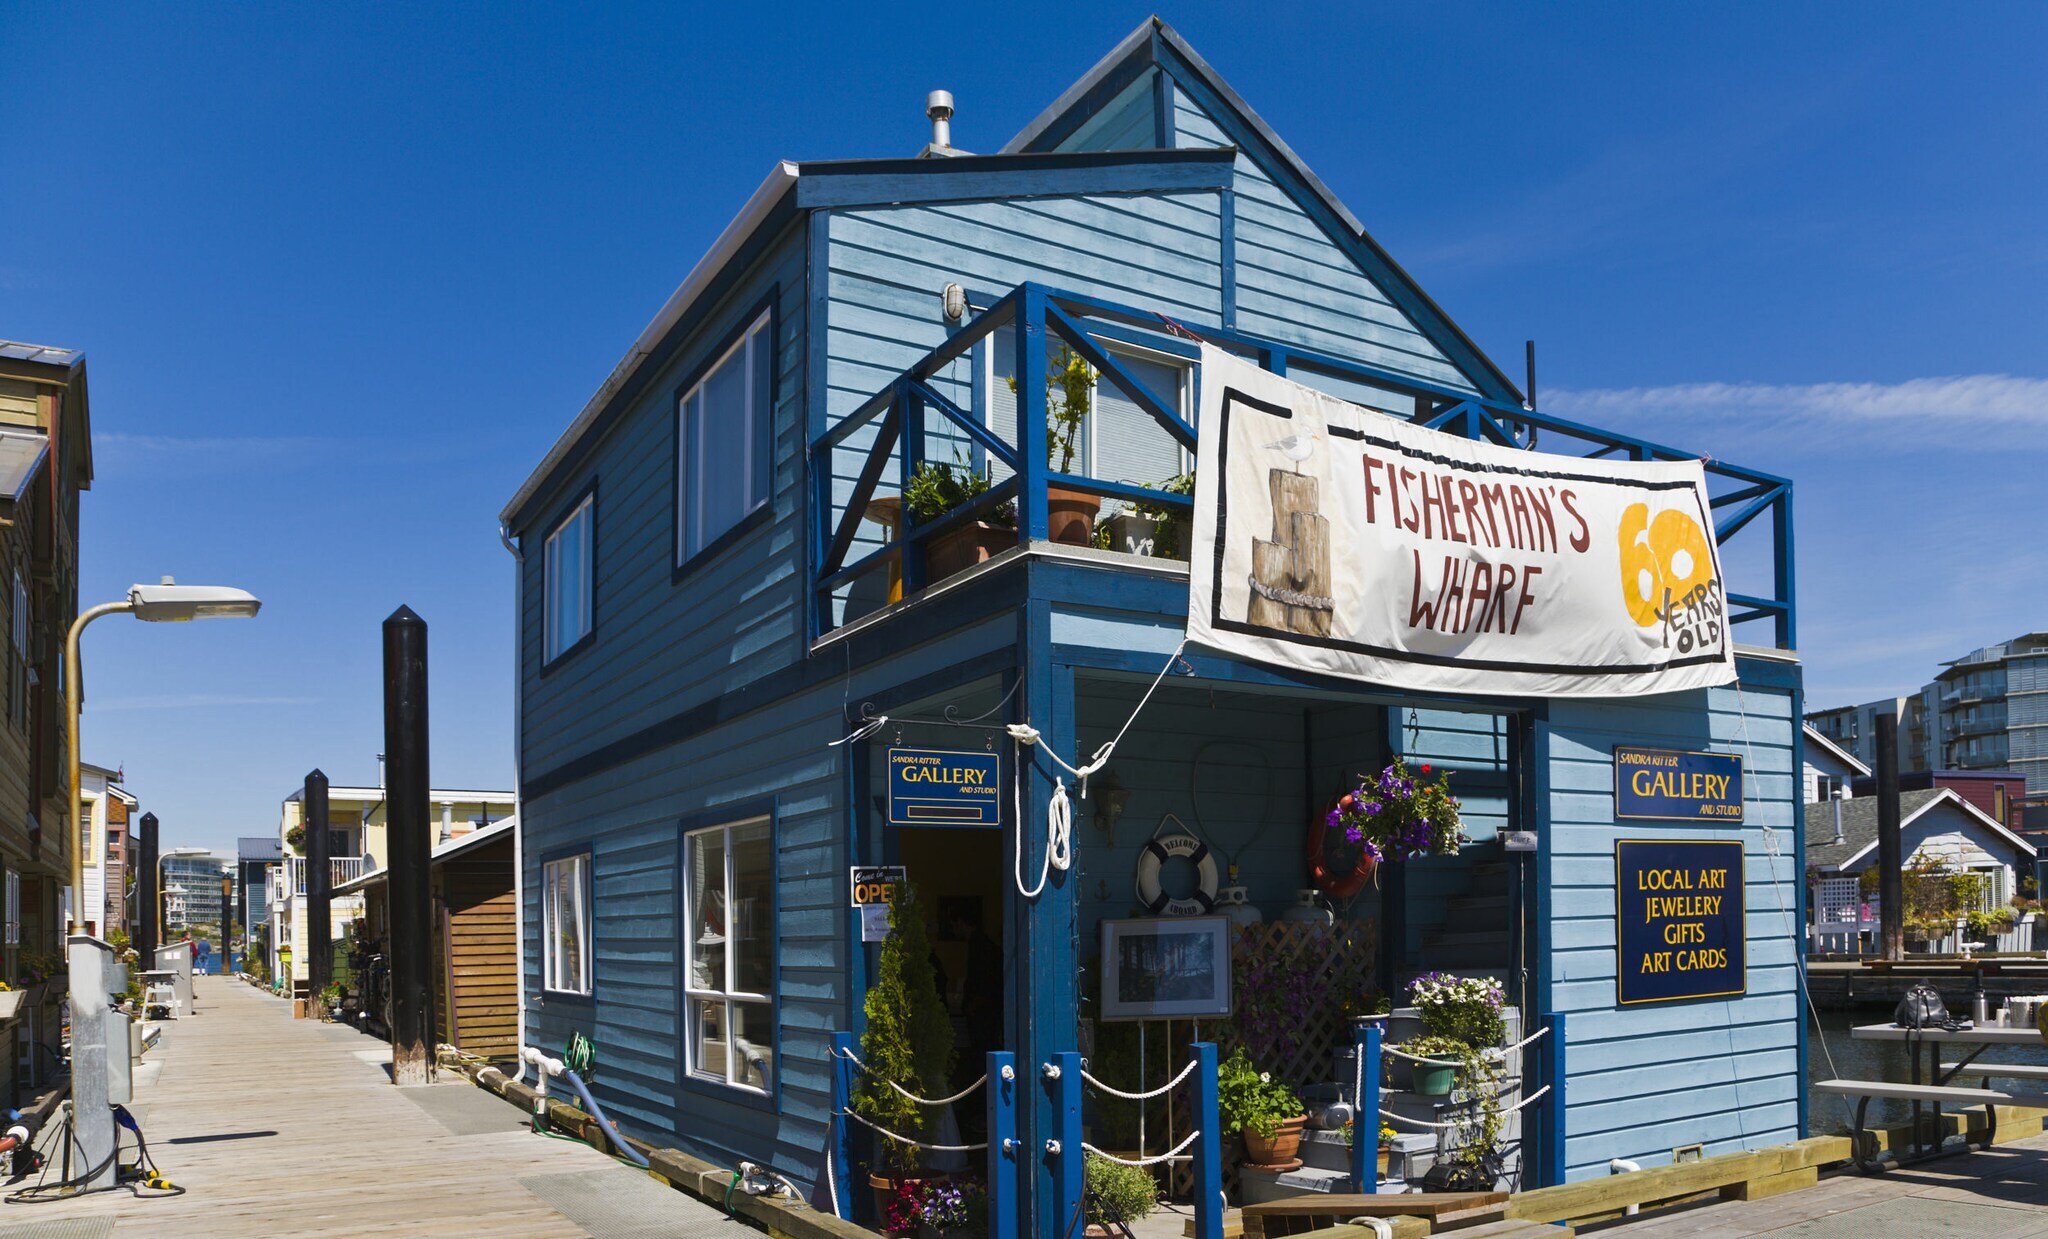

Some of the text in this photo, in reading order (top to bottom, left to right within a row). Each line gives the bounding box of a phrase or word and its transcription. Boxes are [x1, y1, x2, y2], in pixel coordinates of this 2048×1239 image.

[1362, 453, 1591, 554] FISHERMAN'S
[1618, 502, 1713, 628] 60
[1408, 548, 1543, 636] WHARF
[1653, 579, 1723, 649] YEARS
[1677, 620, 1720, 654] OLD
[892, 756, 941, 765] SANDRA RITTER
[1620, 753, 1679, 767] SANDRA RITTER
[901, 765, 987, 785] GALLERY
[1632, 769, 1731, 800] GALLERY
[959, 786, 996, 795] AND STUDIO
[1699, 803, 1741, 816] AND STUDIO
[1164, 839, 1198, 850] WELCOME
[1638, 868, 1728, 891] LOCAL ART
[1645, 895, 1722, 925] JEWELERY
[1663, 922, 1706, 945] GIFTS
[1640, 948, 1729, 974] ART CARDS
